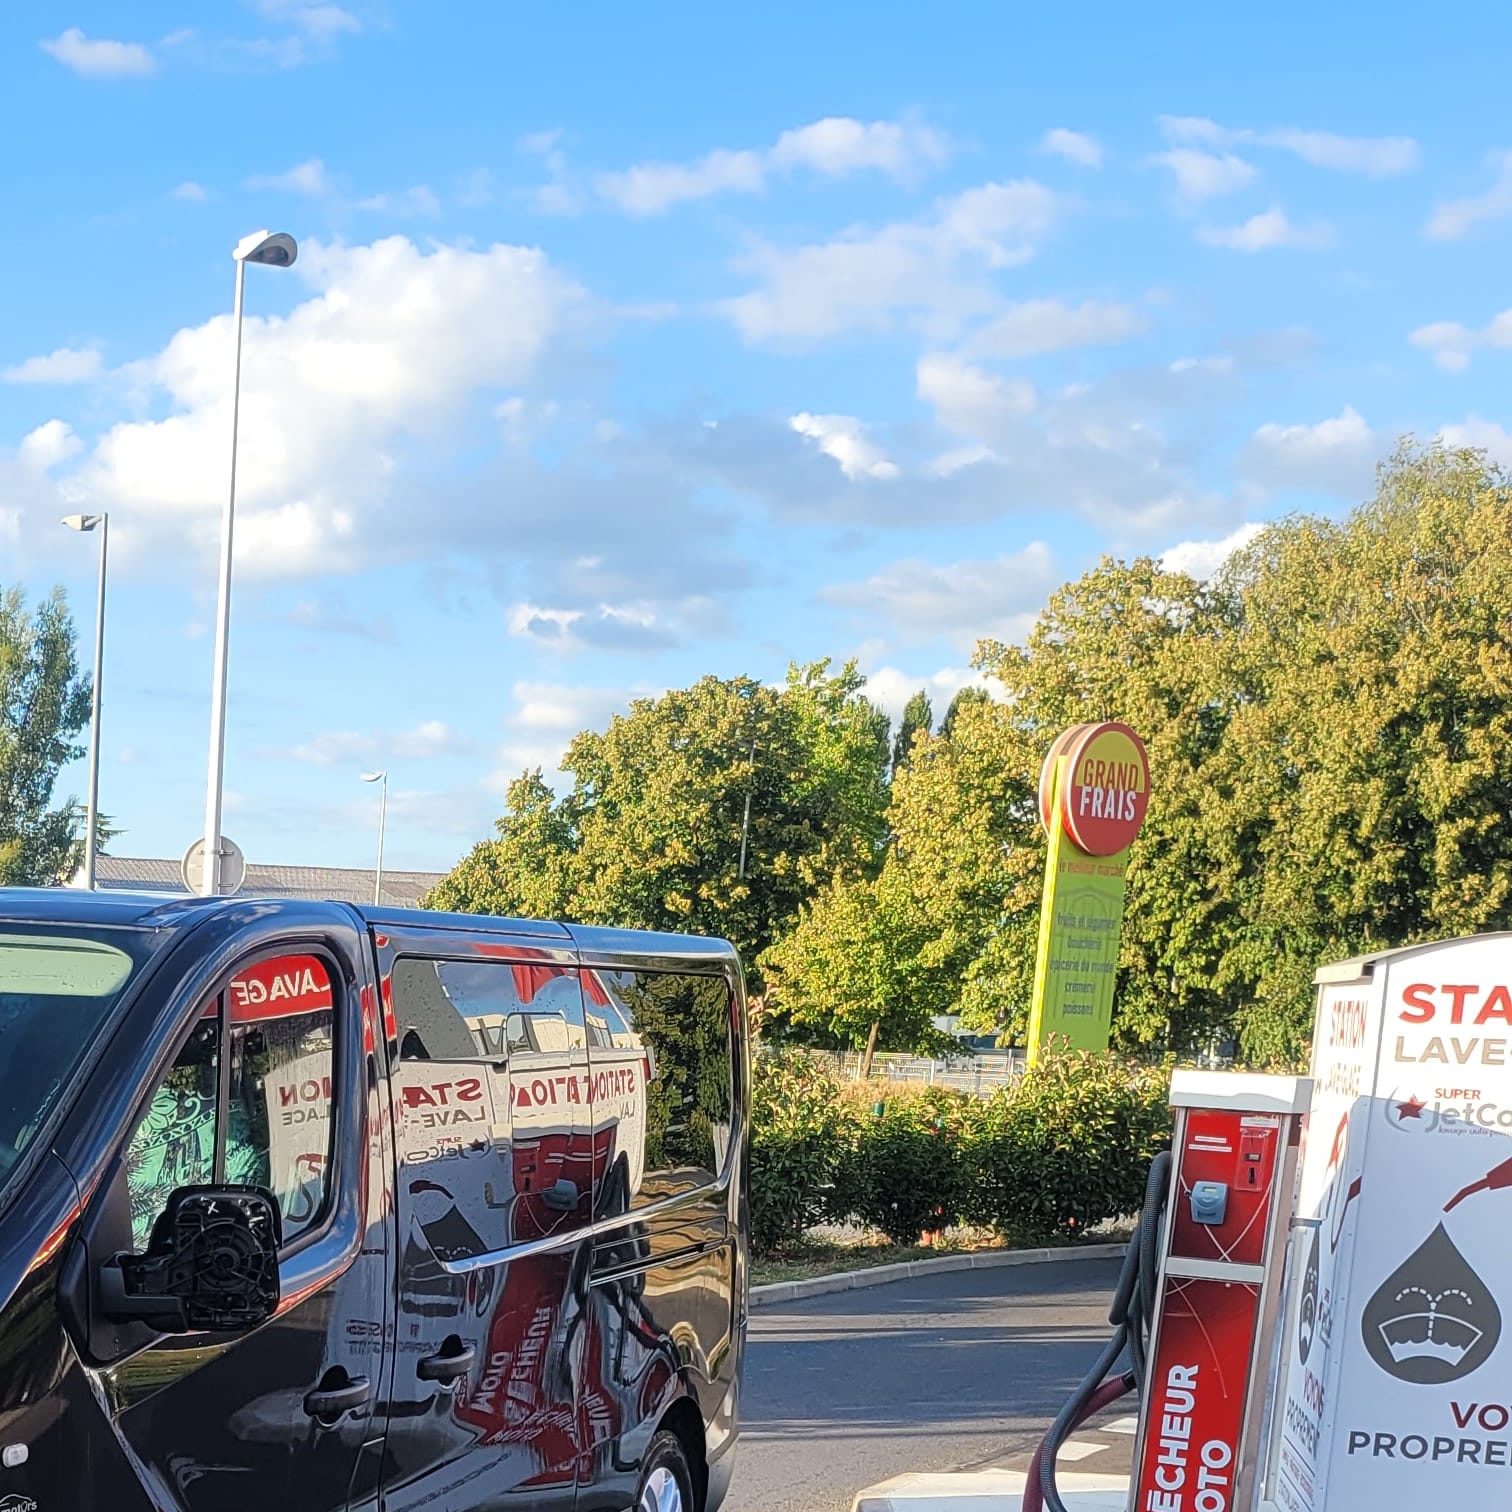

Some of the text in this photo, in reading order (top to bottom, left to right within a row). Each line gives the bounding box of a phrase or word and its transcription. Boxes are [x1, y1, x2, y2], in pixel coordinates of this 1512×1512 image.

[1084, 759, 1139, 790] GRAND
[1080, 786, 1137, 821] FRAIS
[1328, 1000, 1369, 1048] STATION
[1434, 1087, 1481, 1100] SUPER
[1450, 1401, 1512, 1431] VO
[1348, 1431, 1512, 1467] PROPRE
